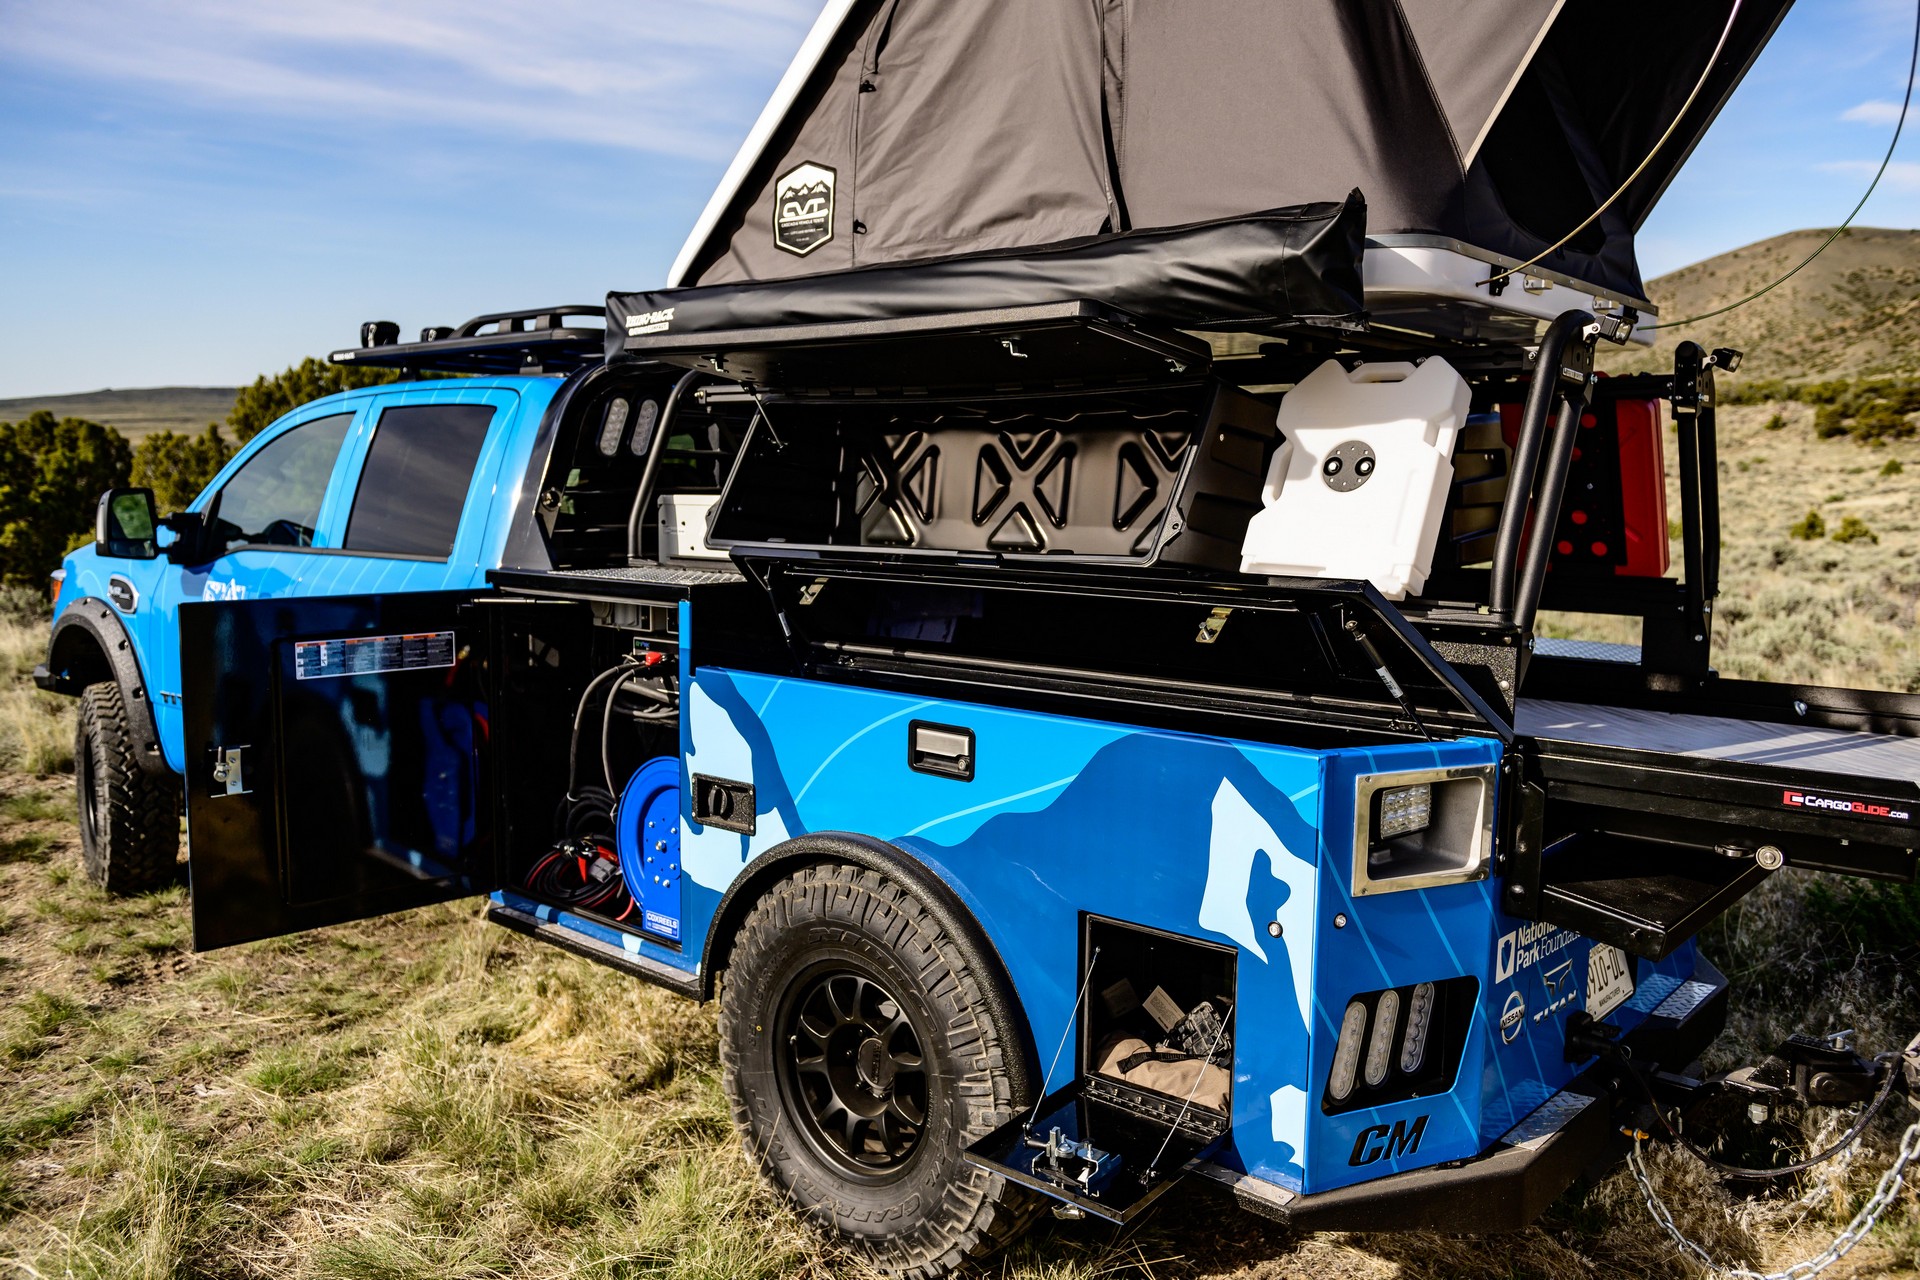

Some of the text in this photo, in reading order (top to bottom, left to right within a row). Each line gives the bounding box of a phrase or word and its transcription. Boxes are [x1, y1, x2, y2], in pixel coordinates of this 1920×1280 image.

[783, 198, 825, 218] CVT
[626, 307, 675, 327] RHINO-RACK
[646, 912, 677, 929] COXREELS
[1517, 920, 1558, 949] Nationa
[1516, 942, 1540, 973] Park
[1533, 989, 1577, 1025] TITAN
[1599, 986, 1621, 1007] MANUFACTURER
[1500, 1005, 1525, 1027] NISSAN
[1348, 1114, 1431, 1167] CM
